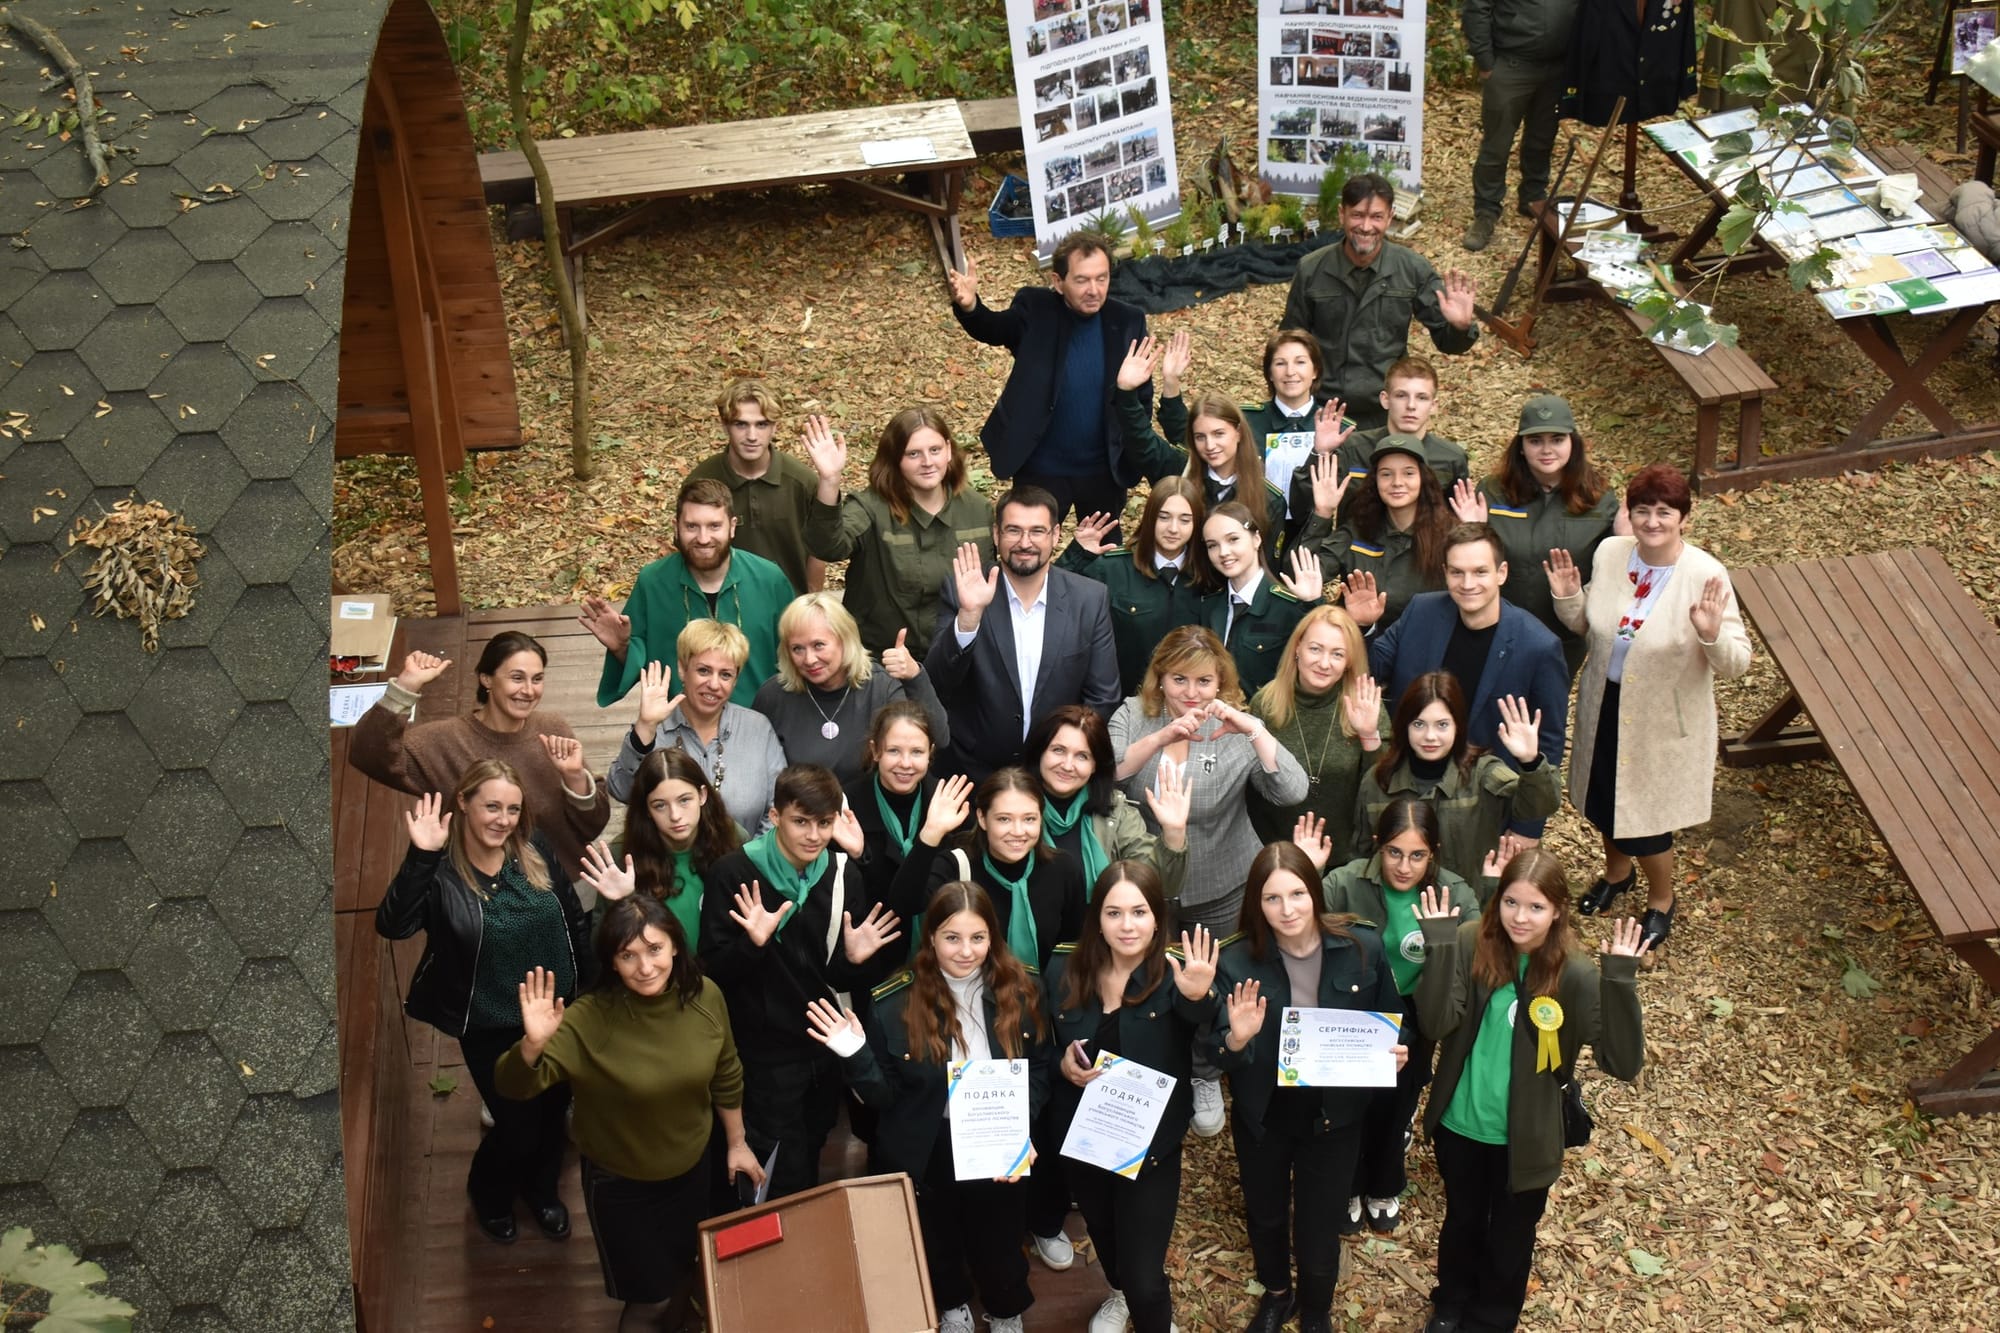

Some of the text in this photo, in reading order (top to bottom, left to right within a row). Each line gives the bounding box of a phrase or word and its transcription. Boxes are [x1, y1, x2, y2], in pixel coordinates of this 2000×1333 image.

[1373, 24, 1398, 32] РОБОТА
[1099, 42, 1123, 54] ТВАРИН
[1286, 99, 1338, 107] ГОСПОДАРСТВА
[1352, 102, 1398, 110] СПЕЦІАЛІСТІВ
[1379, 97, 1412, 105] ЛІСОВОГО
[1112, 122, 1143, 136] КАМПАНІЯ
[1318, 1026, 1380, 1035] СЕРТИФІКАТ
[964, 1090, 1016, 1100] ПОДЯКА
[1101, 1085, 1150, 1108] ПОДЯКА
